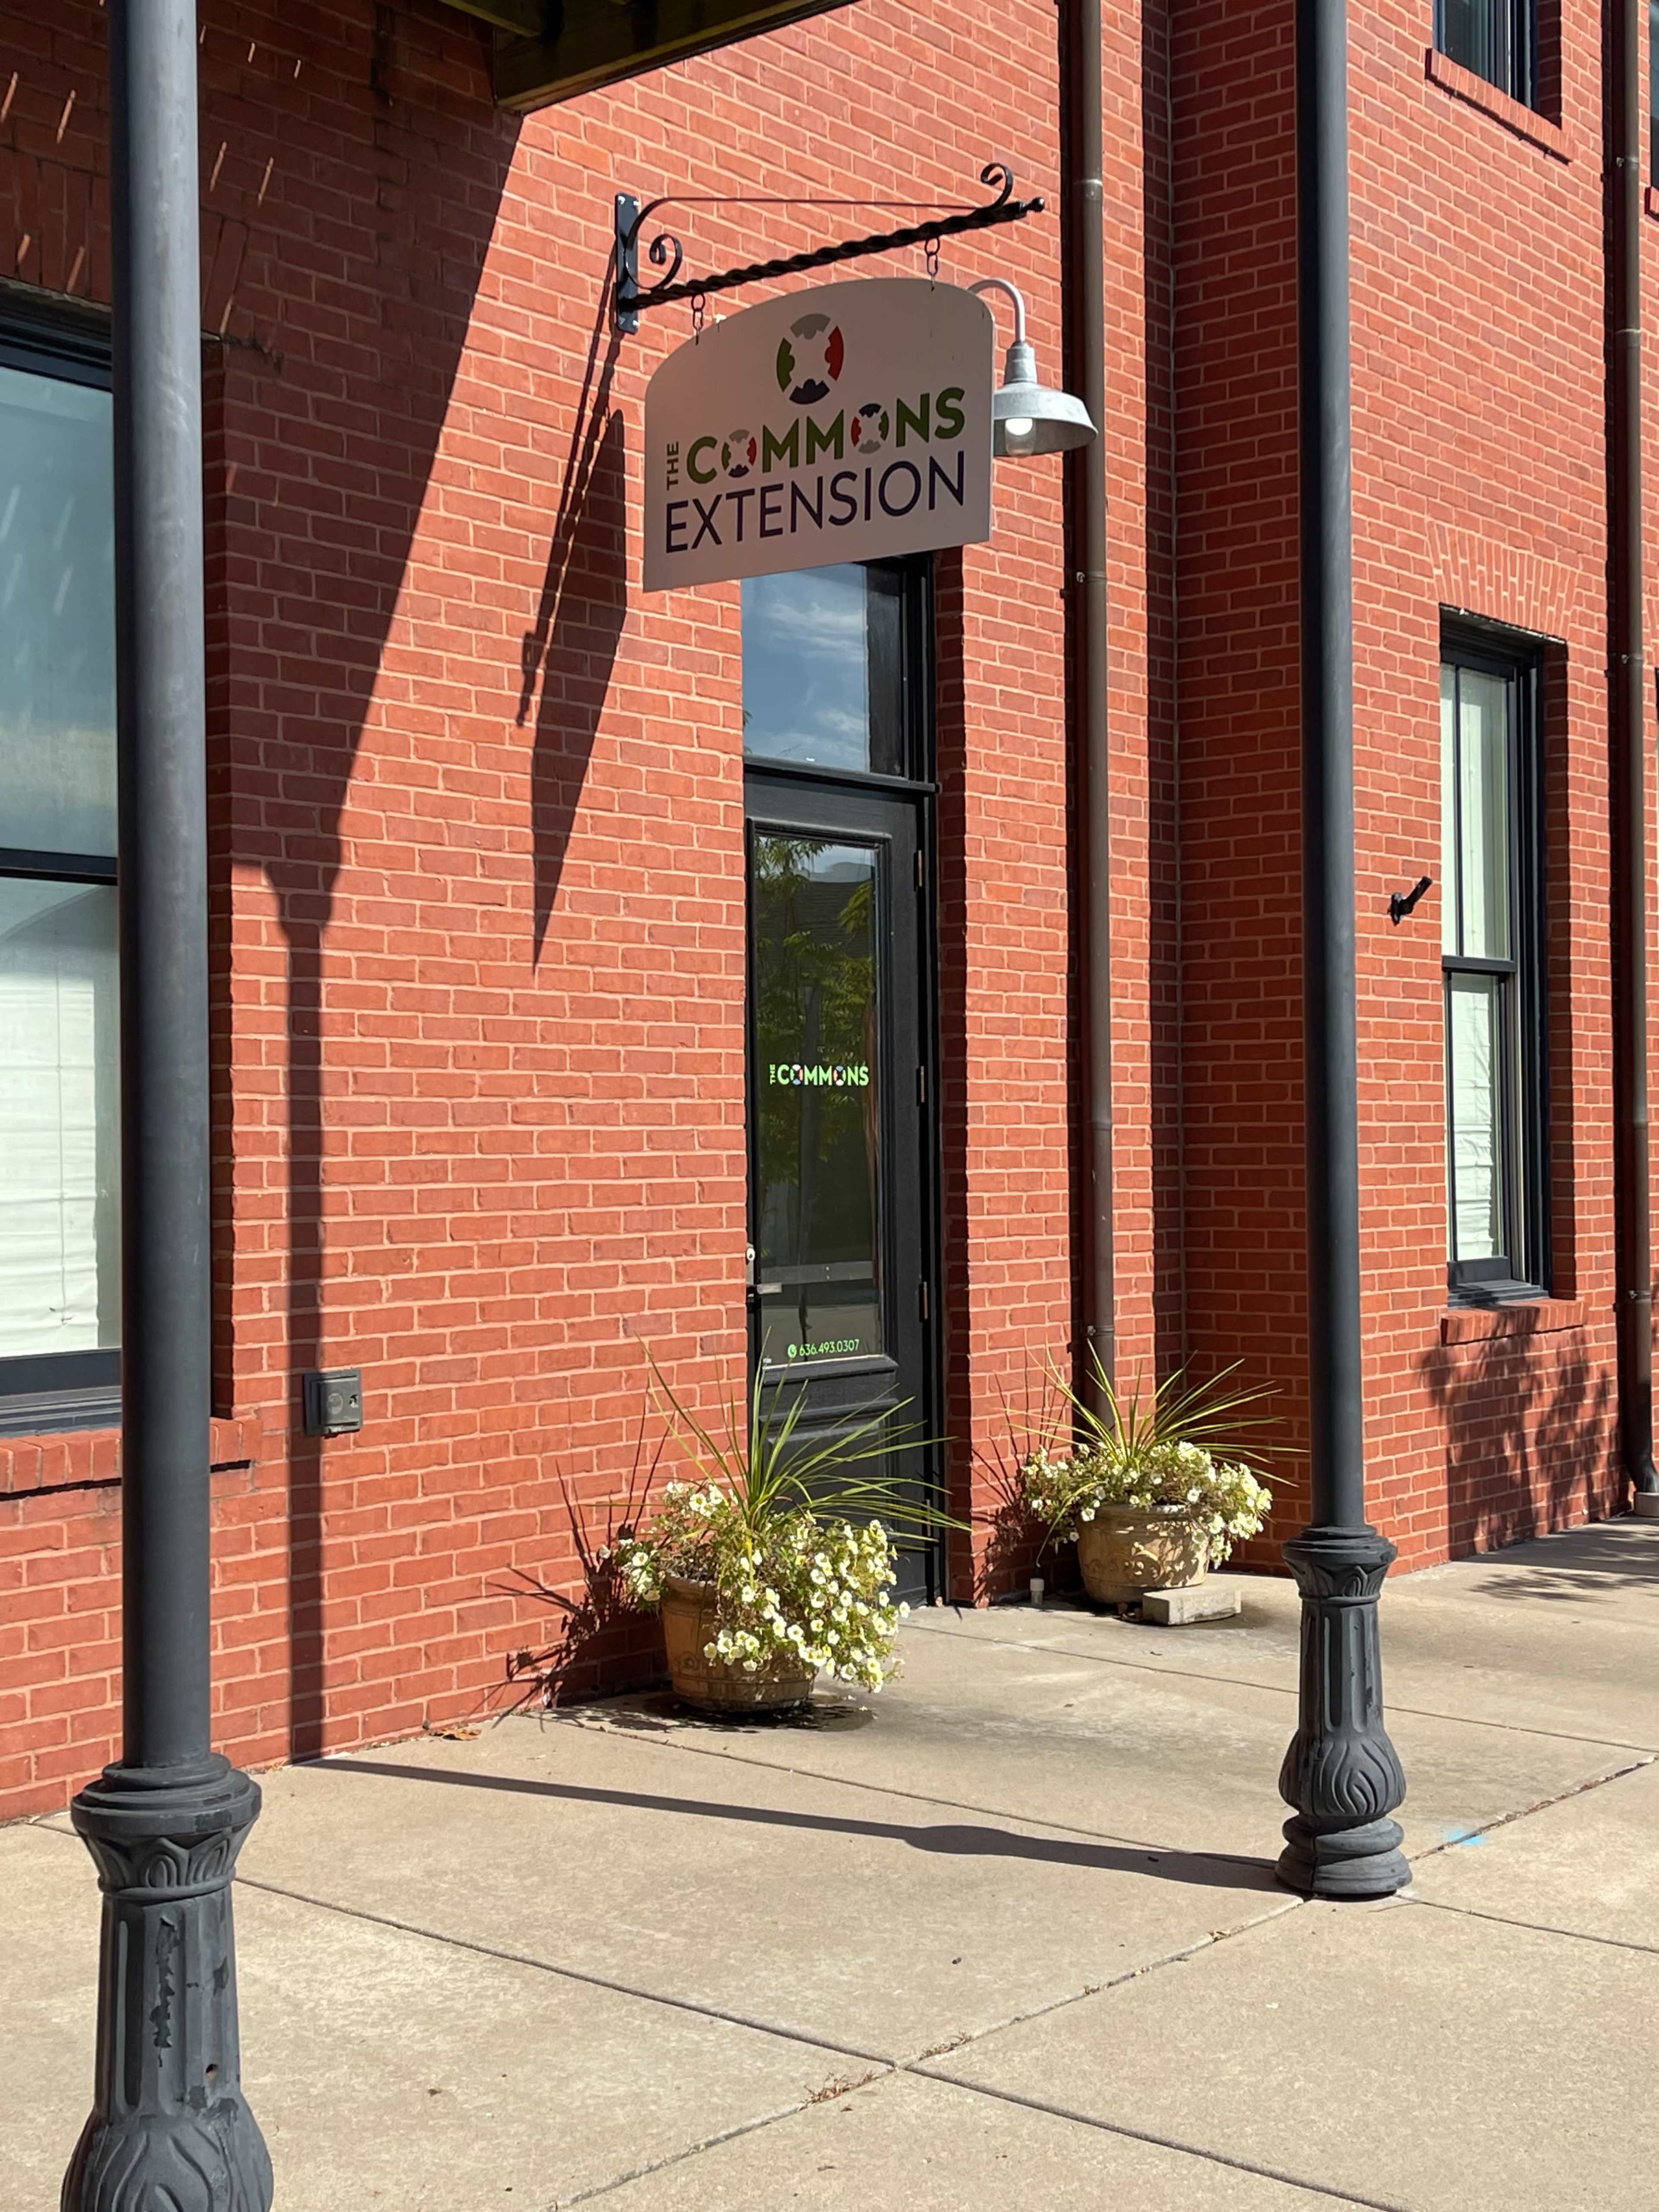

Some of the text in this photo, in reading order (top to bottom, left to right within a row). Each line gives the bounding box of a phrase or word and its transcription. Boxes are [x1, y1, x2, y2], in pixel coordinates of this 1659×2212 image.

[686, 387, 966, 484] COMMONS
[666, 441, 679, 490] THE
[666, 451, 964, 553] EXTENSION
[777, 1064, 869, 1086] COMMONS
[799, 1339, 859, 1356] 636.493.0307
